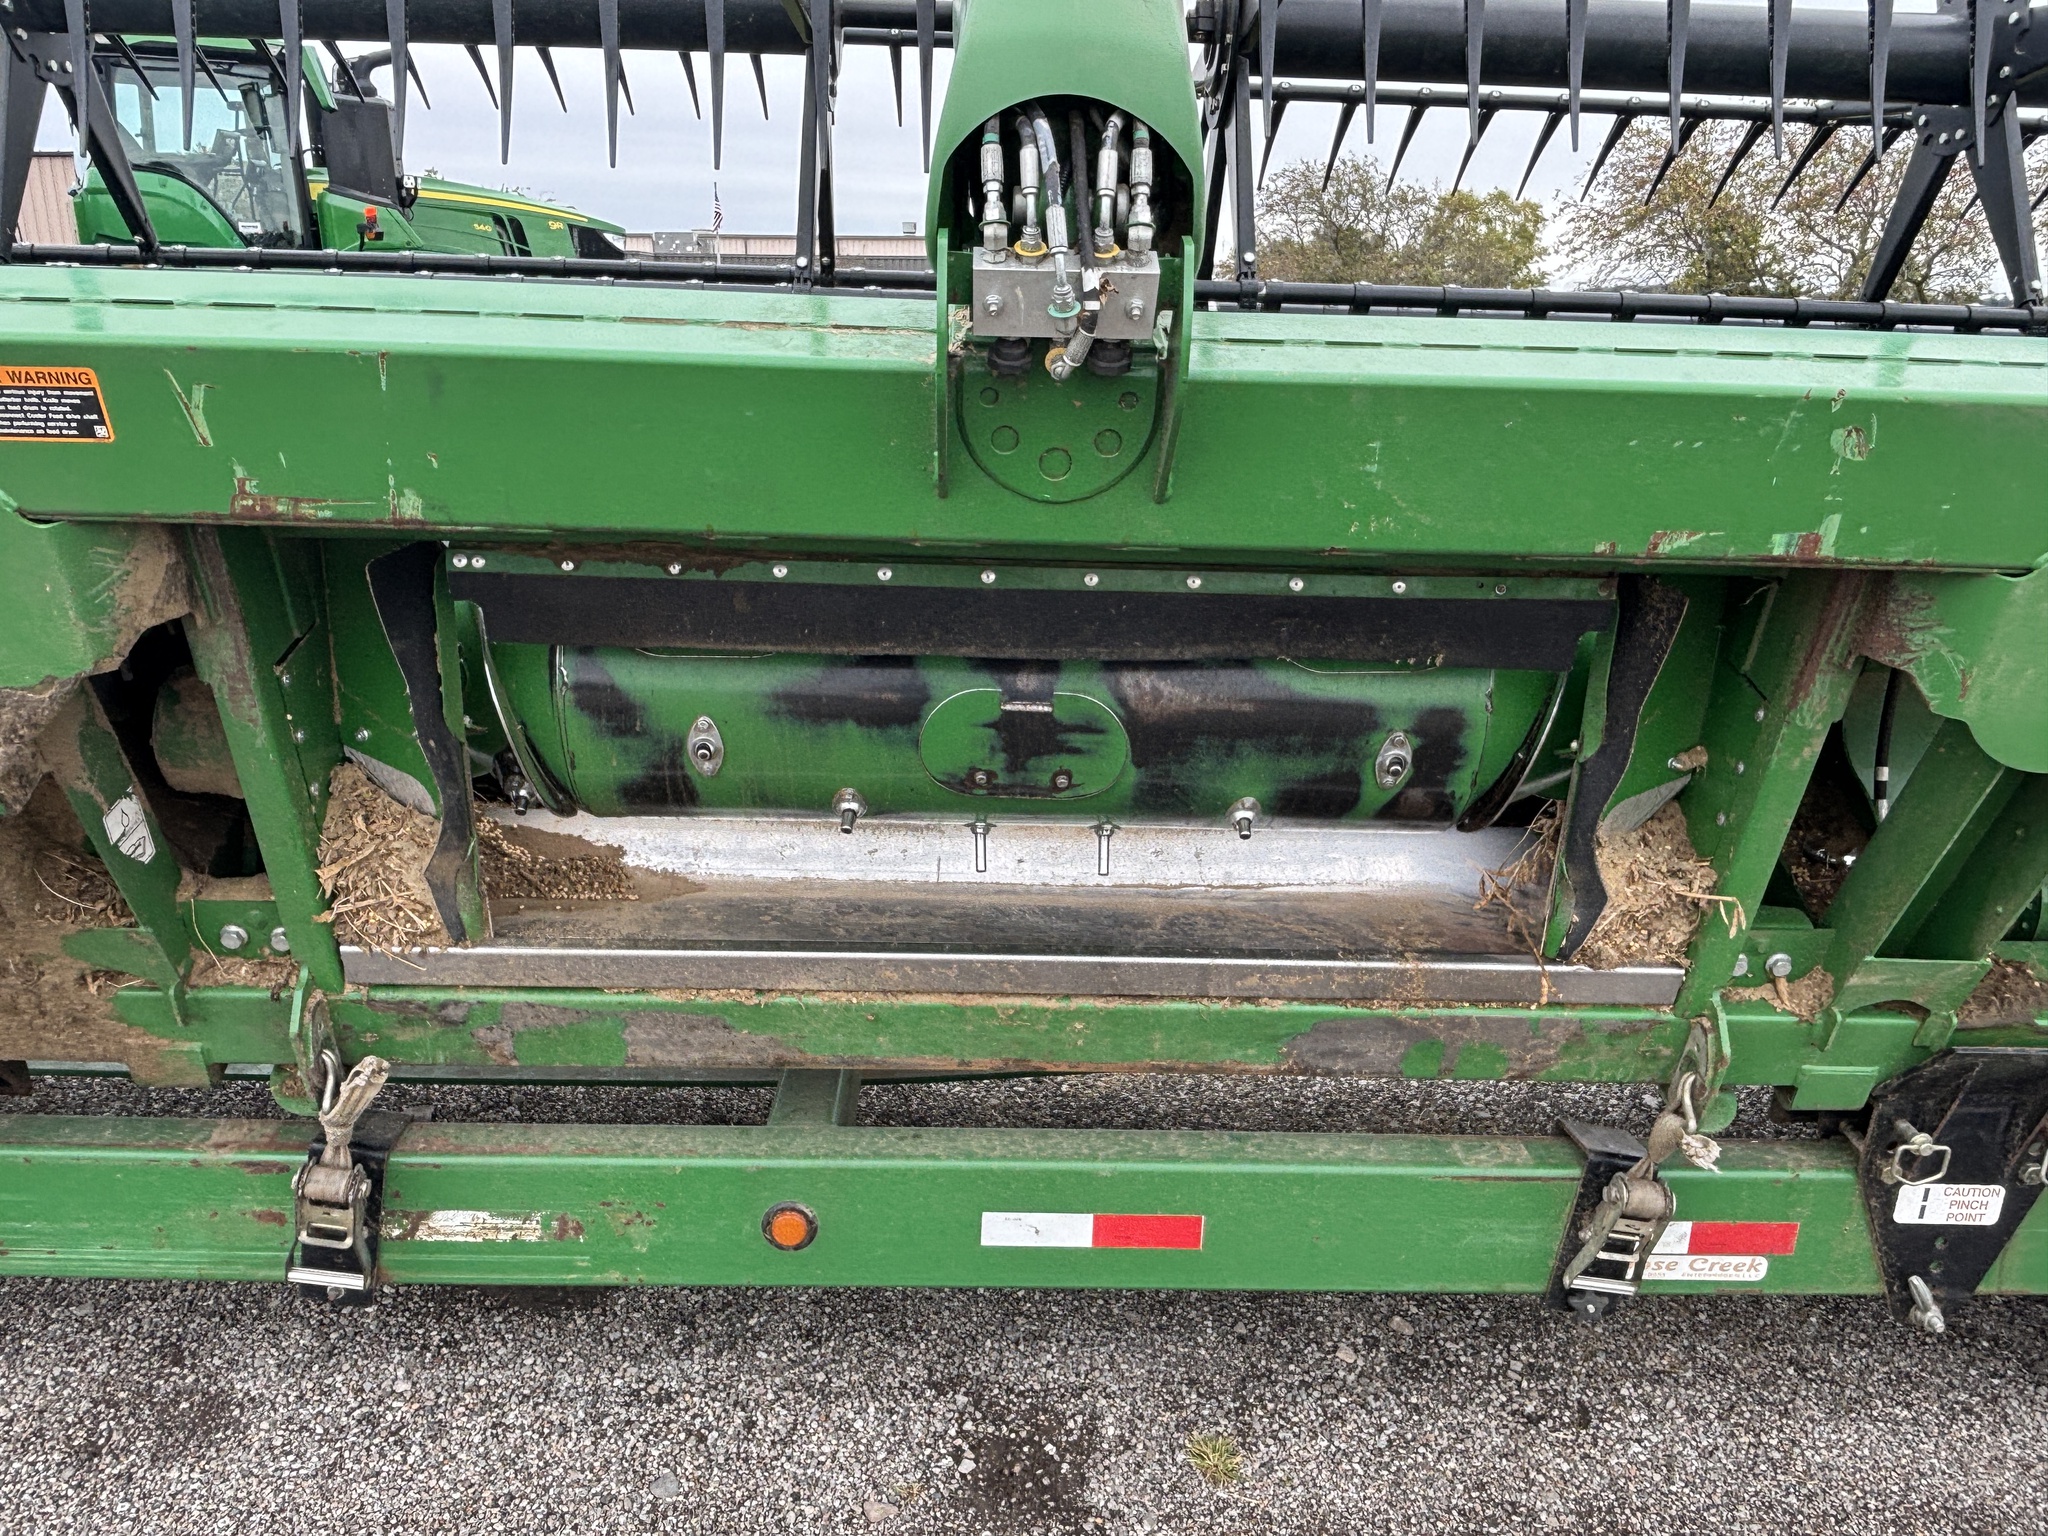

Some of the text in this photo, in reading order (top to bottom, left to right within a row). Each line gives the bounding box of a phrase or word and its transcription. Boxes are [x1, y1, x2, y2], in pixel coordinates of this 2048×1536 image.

[548, 220, 564, 230] 9R
[6, 370, 93, 385] WARNING
[1943, 1187, 2001, 1198] CAUTION
[1948, 1200, 1989, 1211] PINCH
[1946, 1212, 1986, 1222] POINT
[1688, 1257, 1763, 1273] Creek
